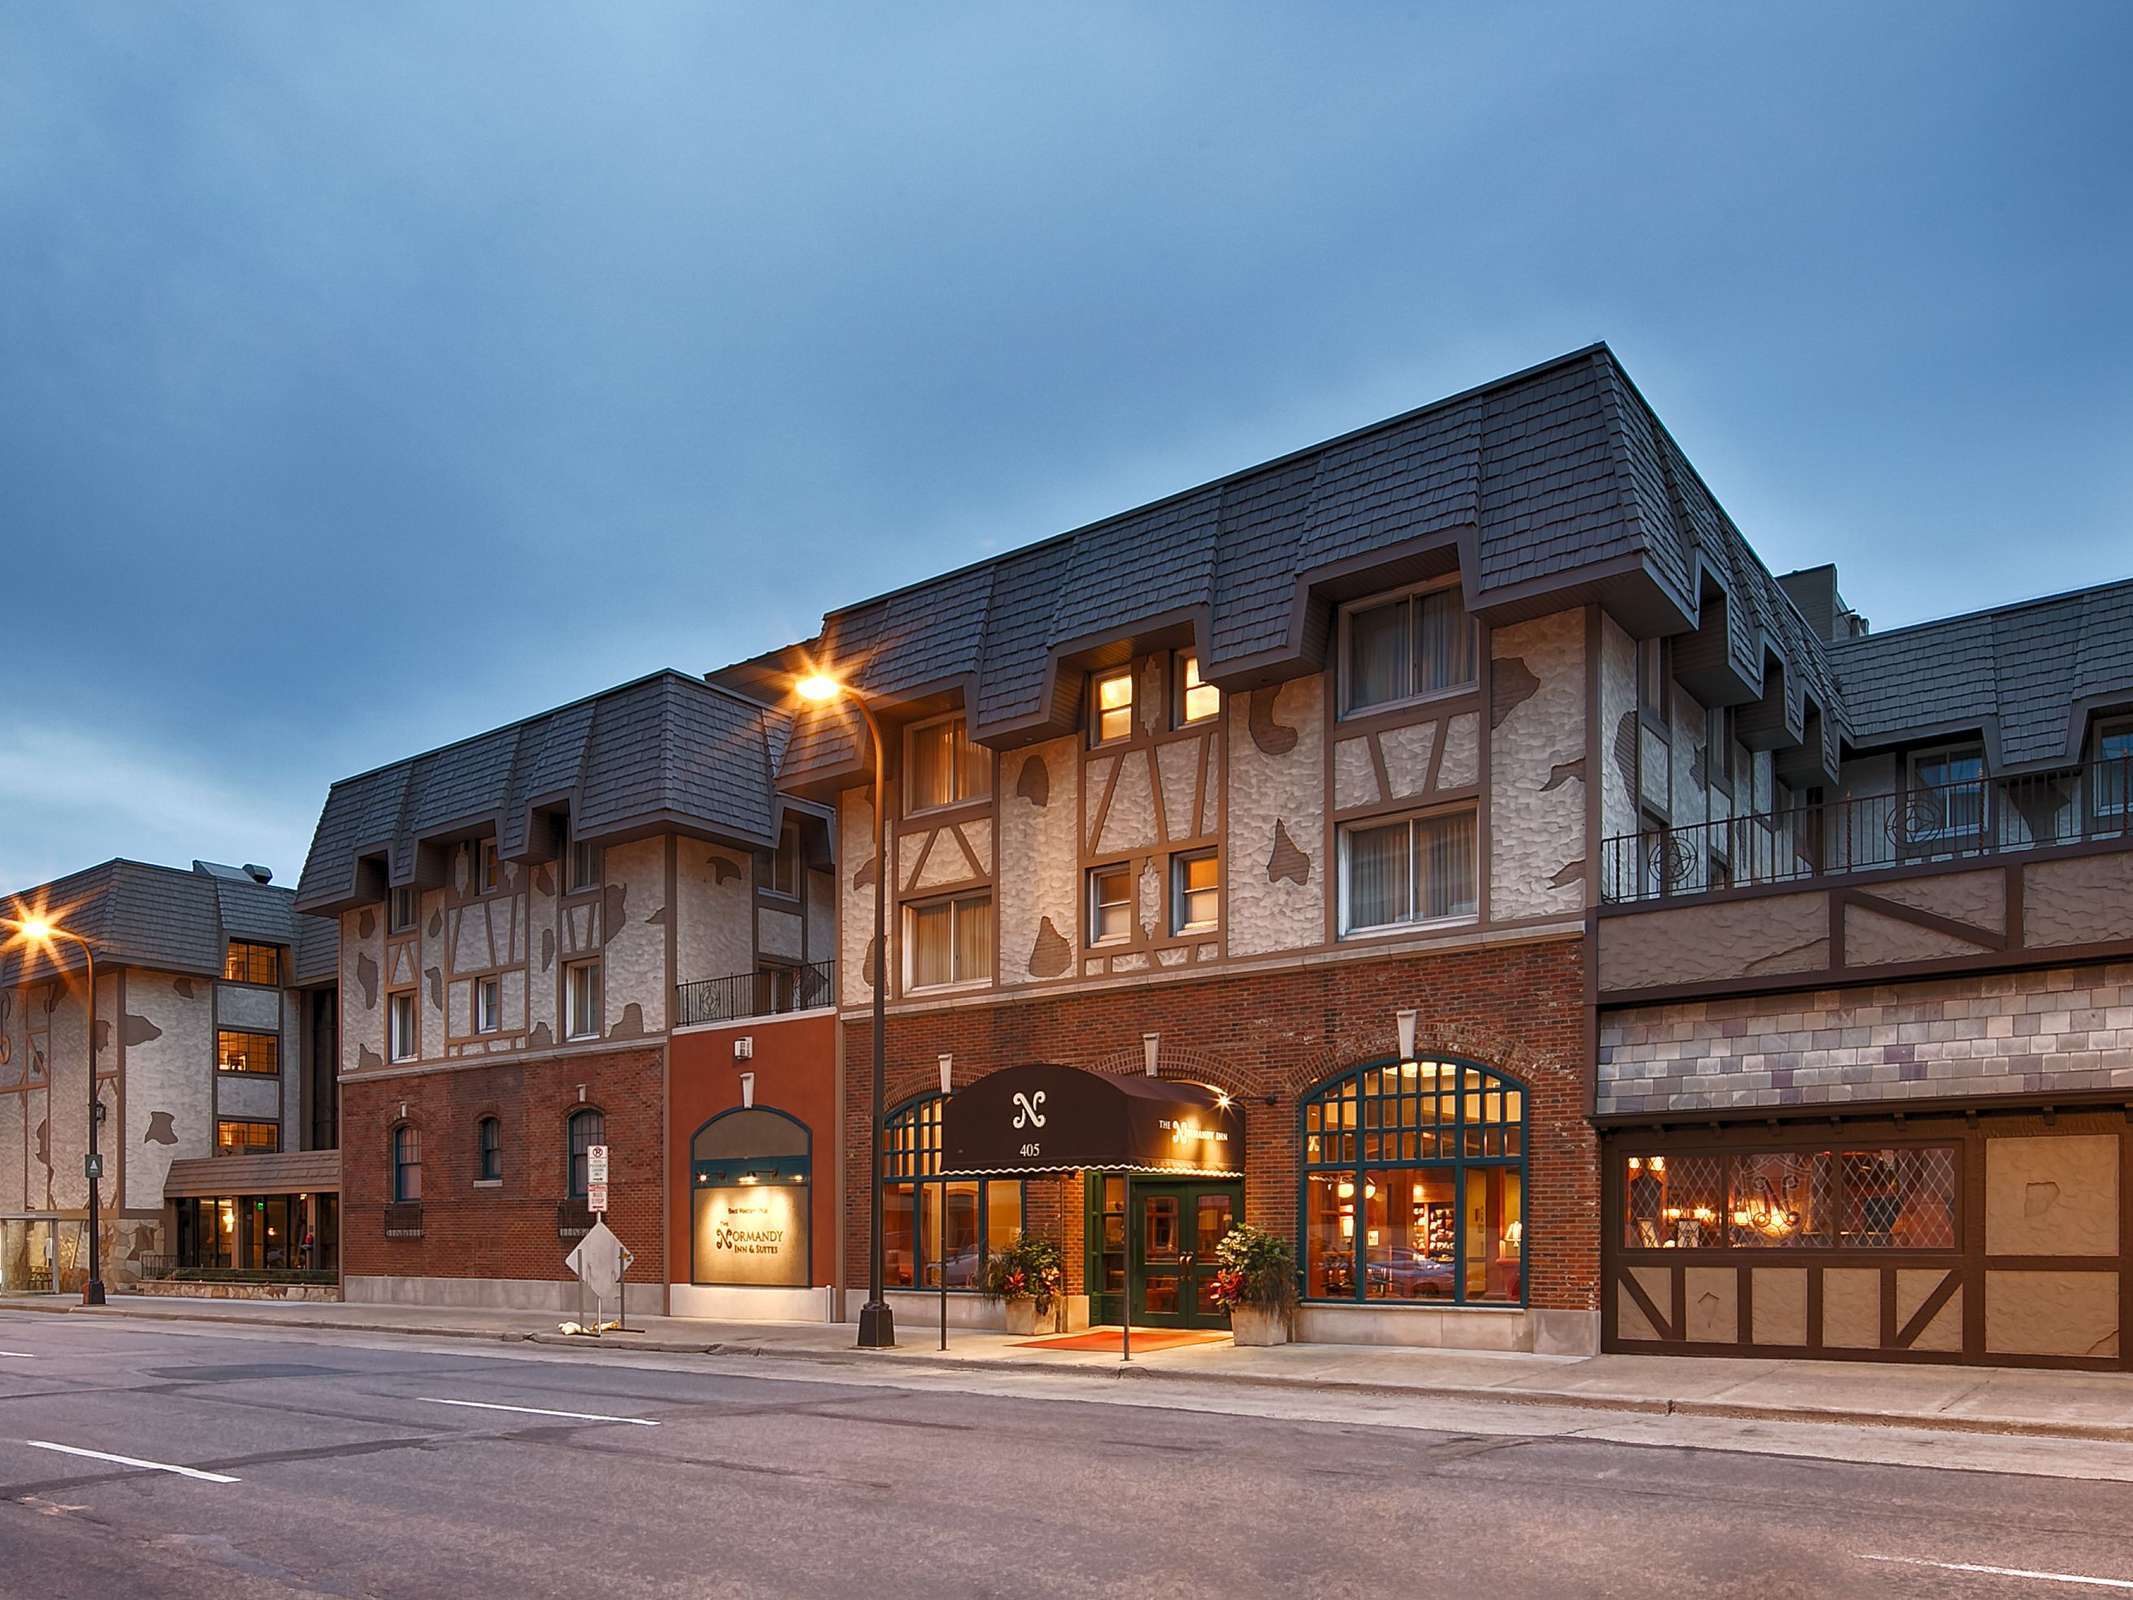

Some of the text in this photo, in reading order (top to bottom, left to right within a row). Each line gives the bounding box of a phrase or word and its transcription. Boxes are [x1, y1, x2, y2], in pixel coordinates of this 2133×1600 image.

[1012, 1090, 1046, 1129] N
[1159, 1120, 1171, 1129] THE
[1019, 1143, 1041, 1158] 405
[716, 1228, 783, 1249] NORMANDY
[734, 1245, 778, 1254] INN & SUITES
